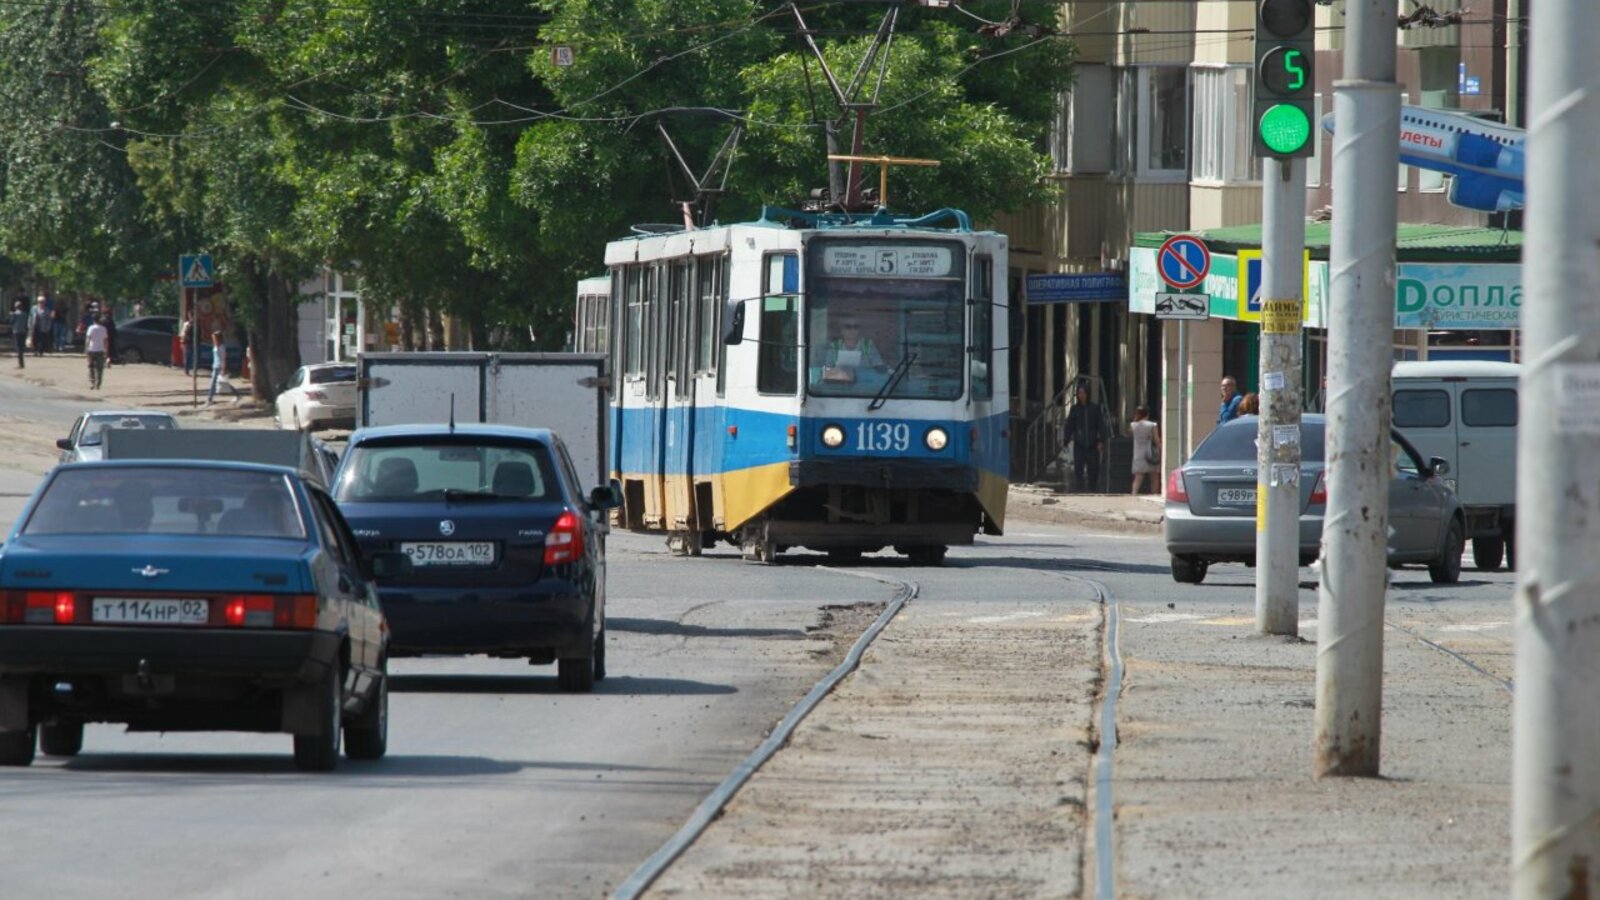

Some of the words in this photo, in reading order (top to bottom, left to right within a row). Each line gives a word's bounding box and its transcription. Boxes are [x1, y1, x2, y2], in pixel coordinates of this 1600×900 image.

[1285, 51, 1303, 89] 5
[880, 252, 894, 273] 5
[857, 422, 910, 451] 1139
[468, 544, 490, 556] 102
[183, 601, 202, 616] 02
